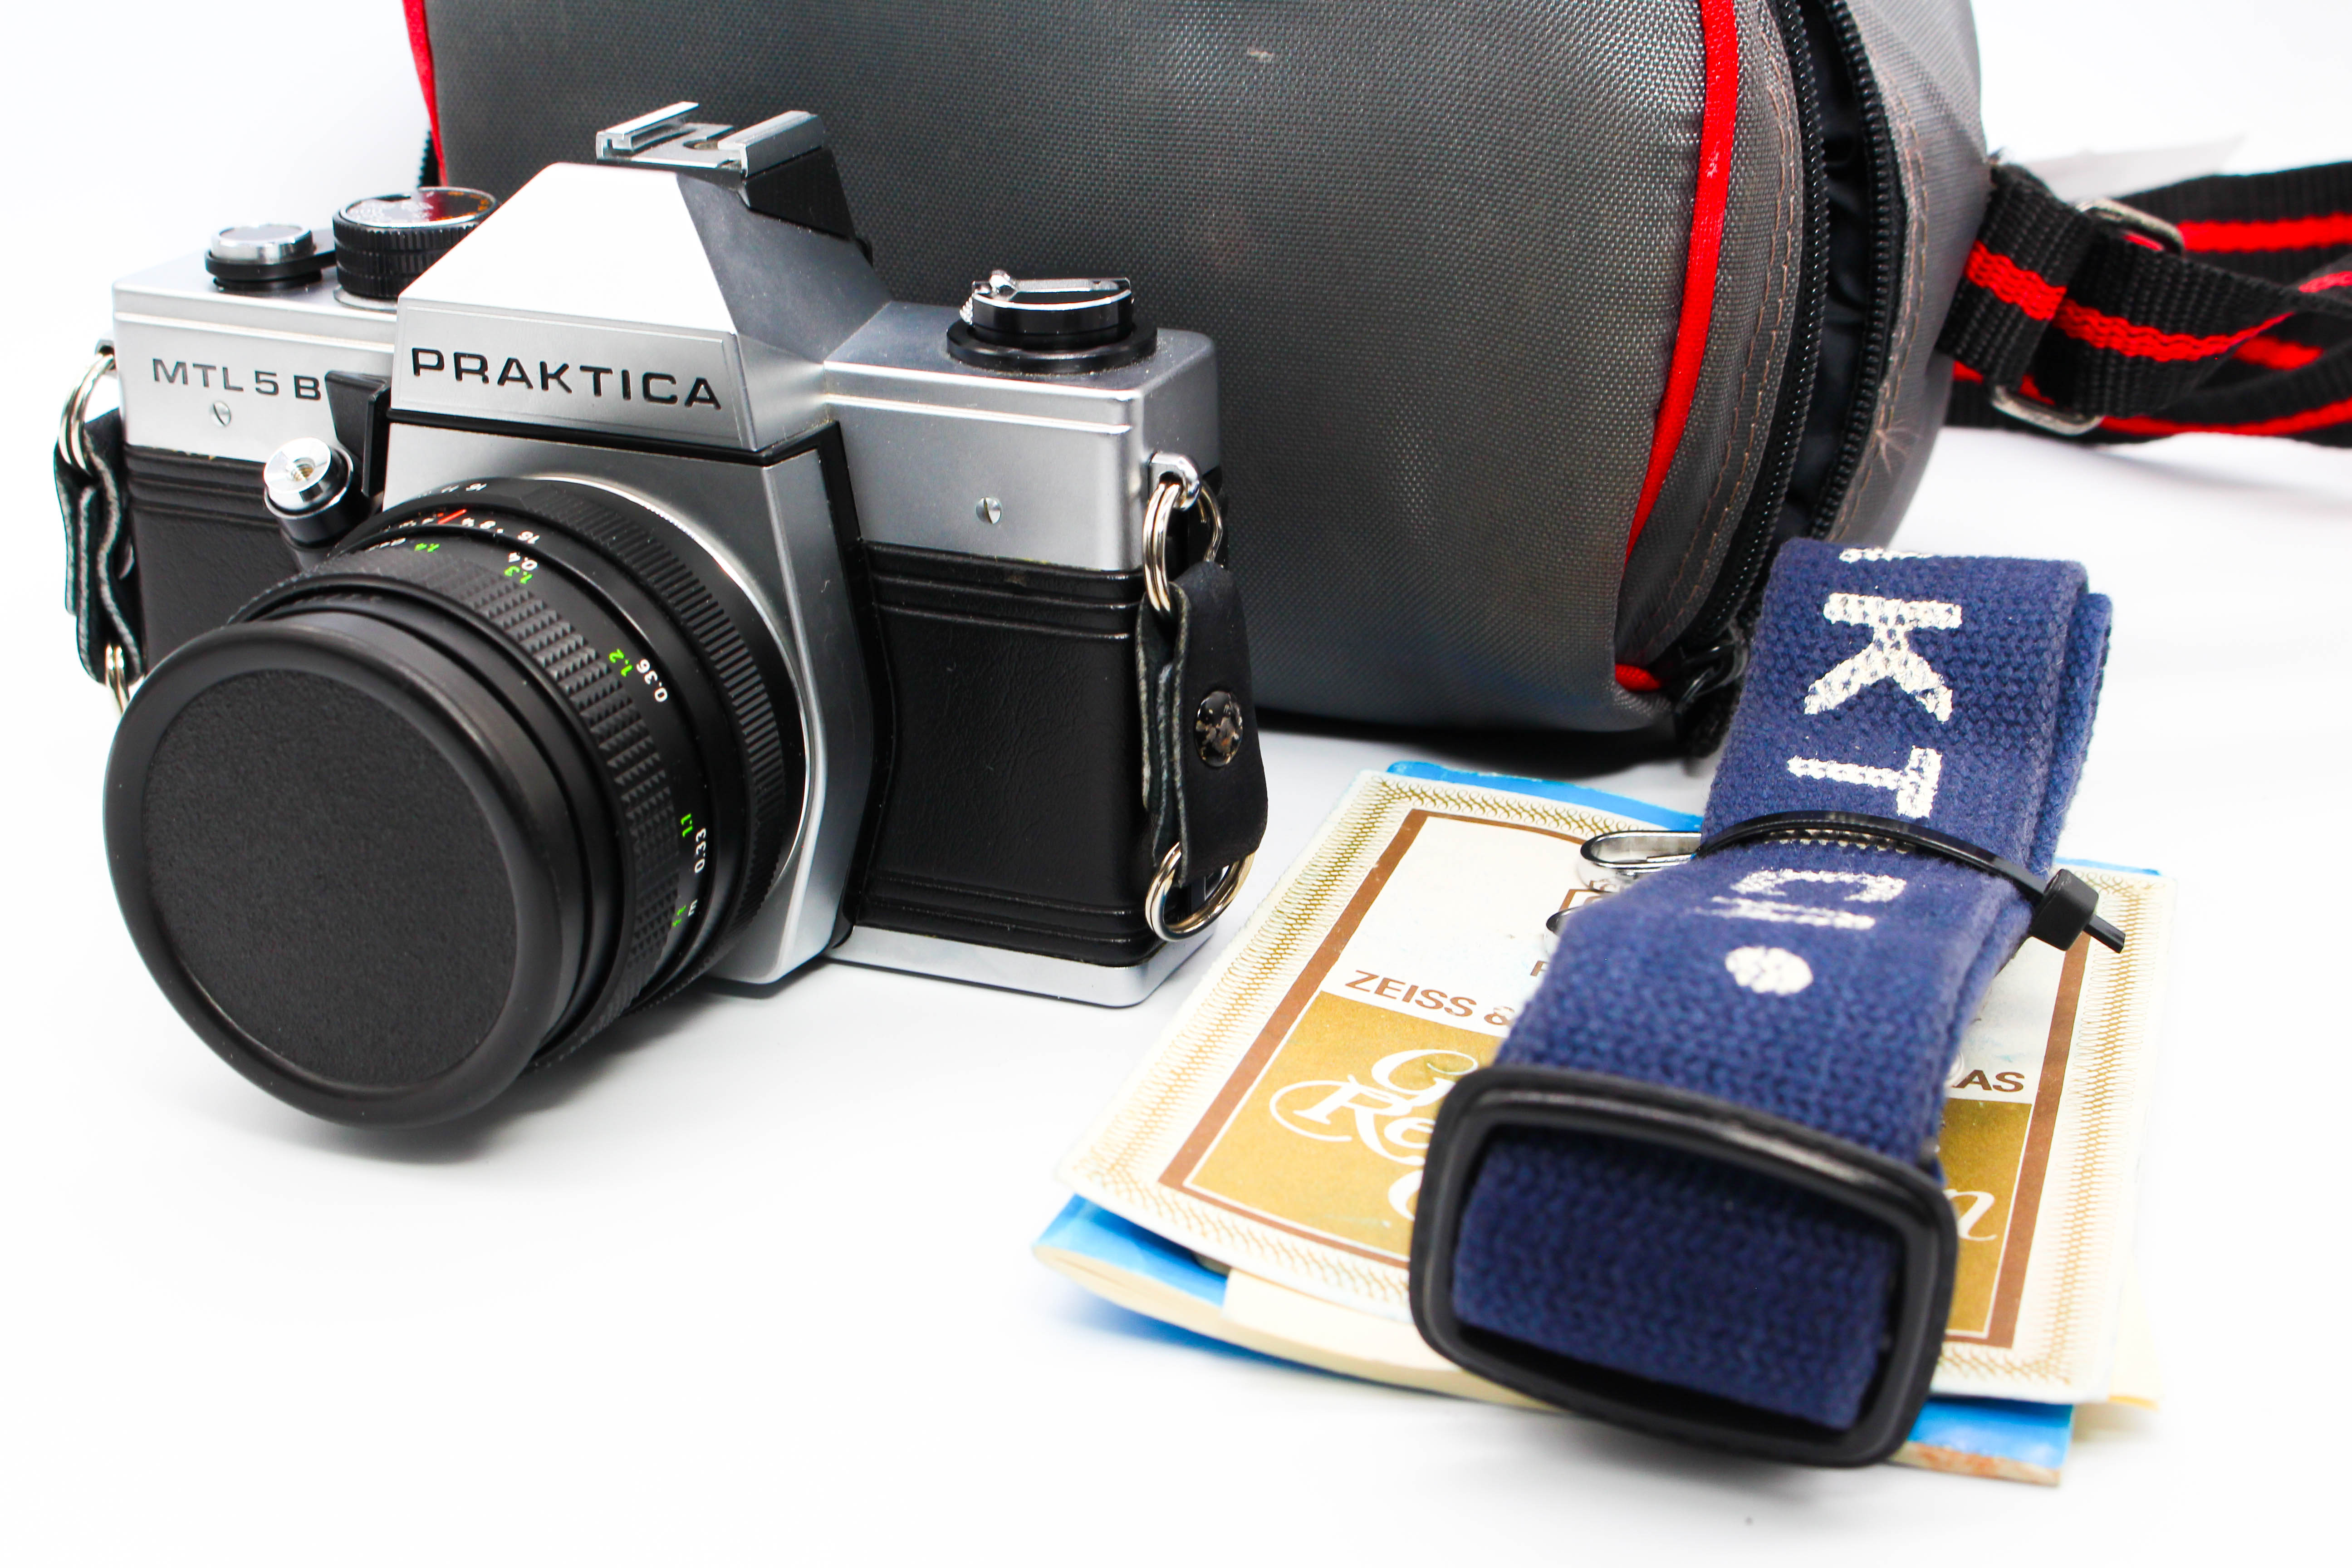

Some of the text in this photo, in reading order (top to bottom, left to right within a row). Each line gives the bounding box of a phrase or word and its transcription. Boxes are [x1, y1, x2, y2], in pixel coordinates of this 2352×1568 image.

[412, 348, 722, 410] PRAKTICA
[608, 648, 633, 677] 1.2
[636, 658, 668, 702] 0.36
[694, 827, 706, 874] 0.33
[1344, 970, 1477, 1018] ZEISS
